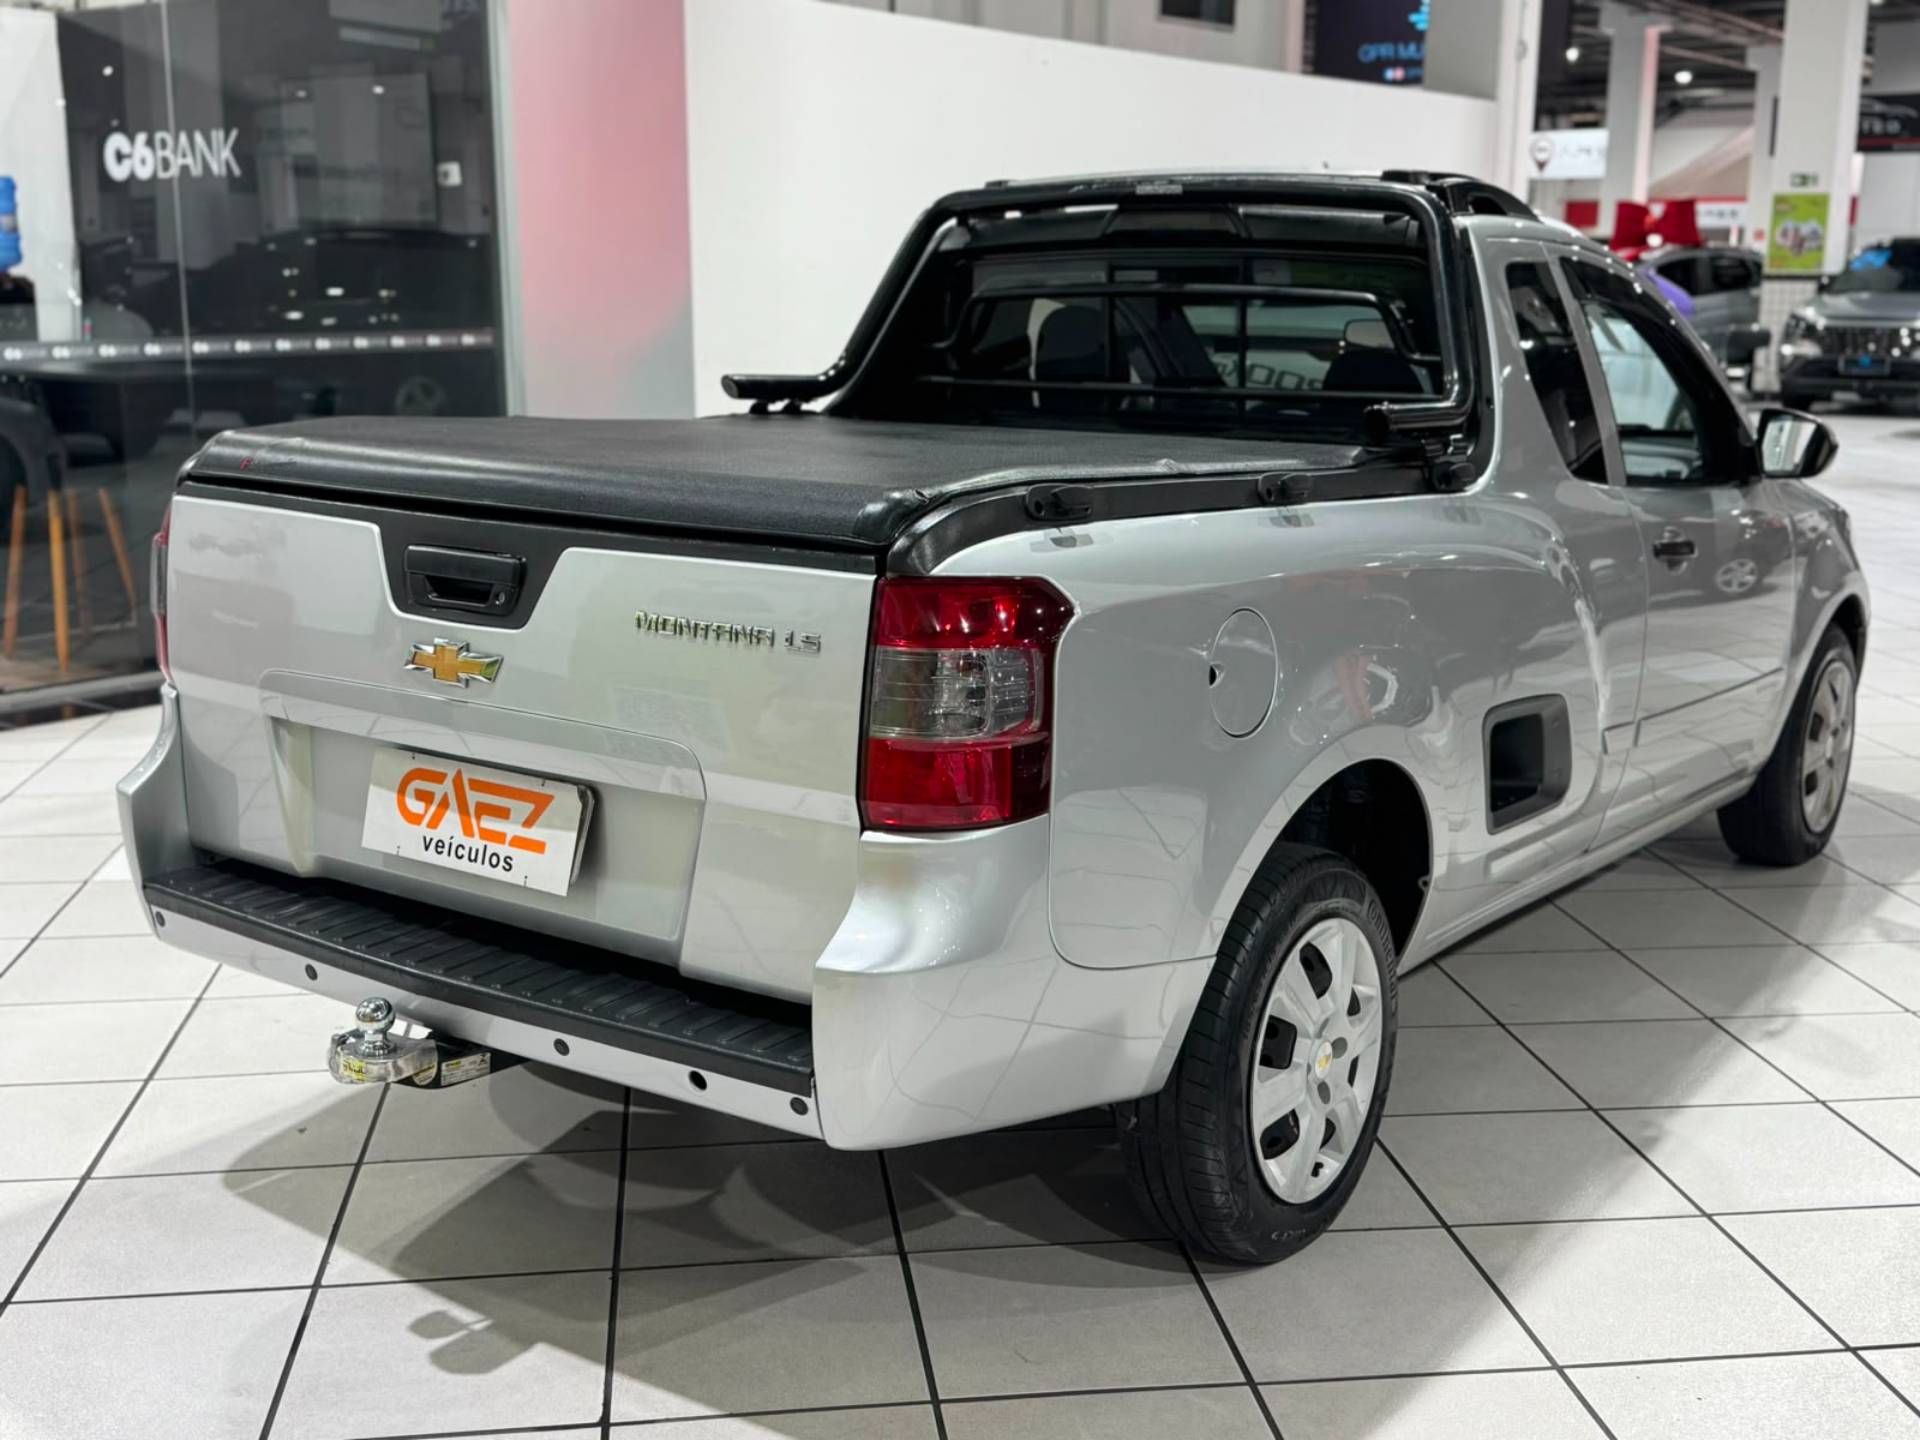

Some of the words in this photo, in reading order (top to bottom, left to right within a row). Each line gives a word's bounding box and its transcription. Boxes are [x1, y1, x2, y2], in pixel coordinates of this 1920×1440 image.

[635, 610, 775, 648] MONTANA
[784, 630, 822, 653] LS
[396, 767, 554, 855] GAEZ
[422, 836, 514, 872] veículos
